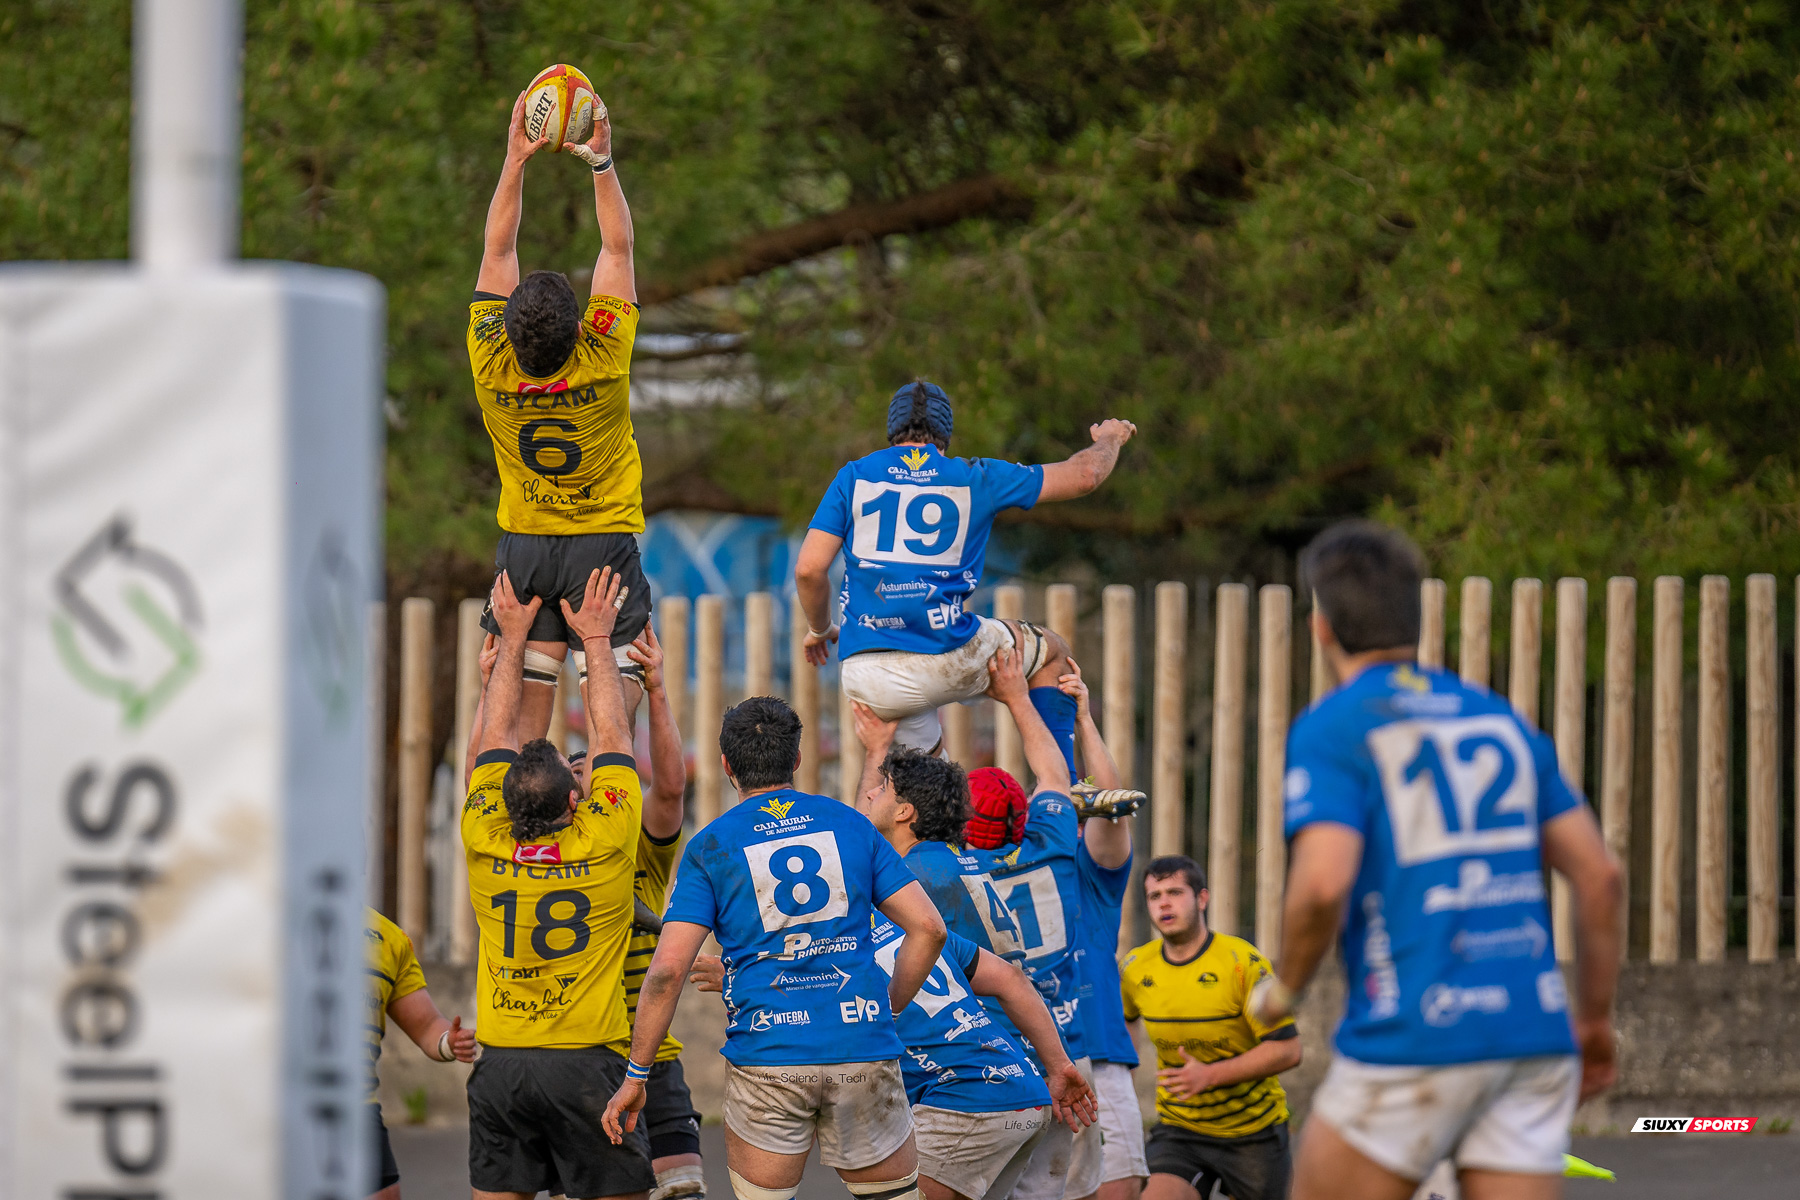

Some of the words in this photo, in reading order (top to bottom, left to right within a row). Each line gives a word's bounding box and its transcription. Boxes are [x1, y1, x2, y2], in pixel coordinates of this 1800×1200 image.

[527, 92, 552, 143] ILBERT
[495, 386, 599, 410] BYCAM
[518, 418, 582, 476] 6
[888, 466, 909, 476] CAJA
[910, 468, 939, 478] RURAL
[862, 489, 960, 556] 19
[880, 580, 928, 592] Asturmine
[875, 617, 905, 628] INTEGRA
[1403, 733, 1526, 835] 12
[753, 821, 779, 832] CAJA
[779, 815, 814, 827] RURAL
[776, 824, 807, 834] ASTURIAS
[492, 858, 590, 879] BYCAM
[768, 845, 830, 917] 8
[983, 880, 1020, 943] 4
[491, 889, 591, 960] 18
[780, 973, 840, 985] Asturmine
[812, 981, 839, 989] vanguardia
[773, 1009, 810, 1025] INTEGRA
